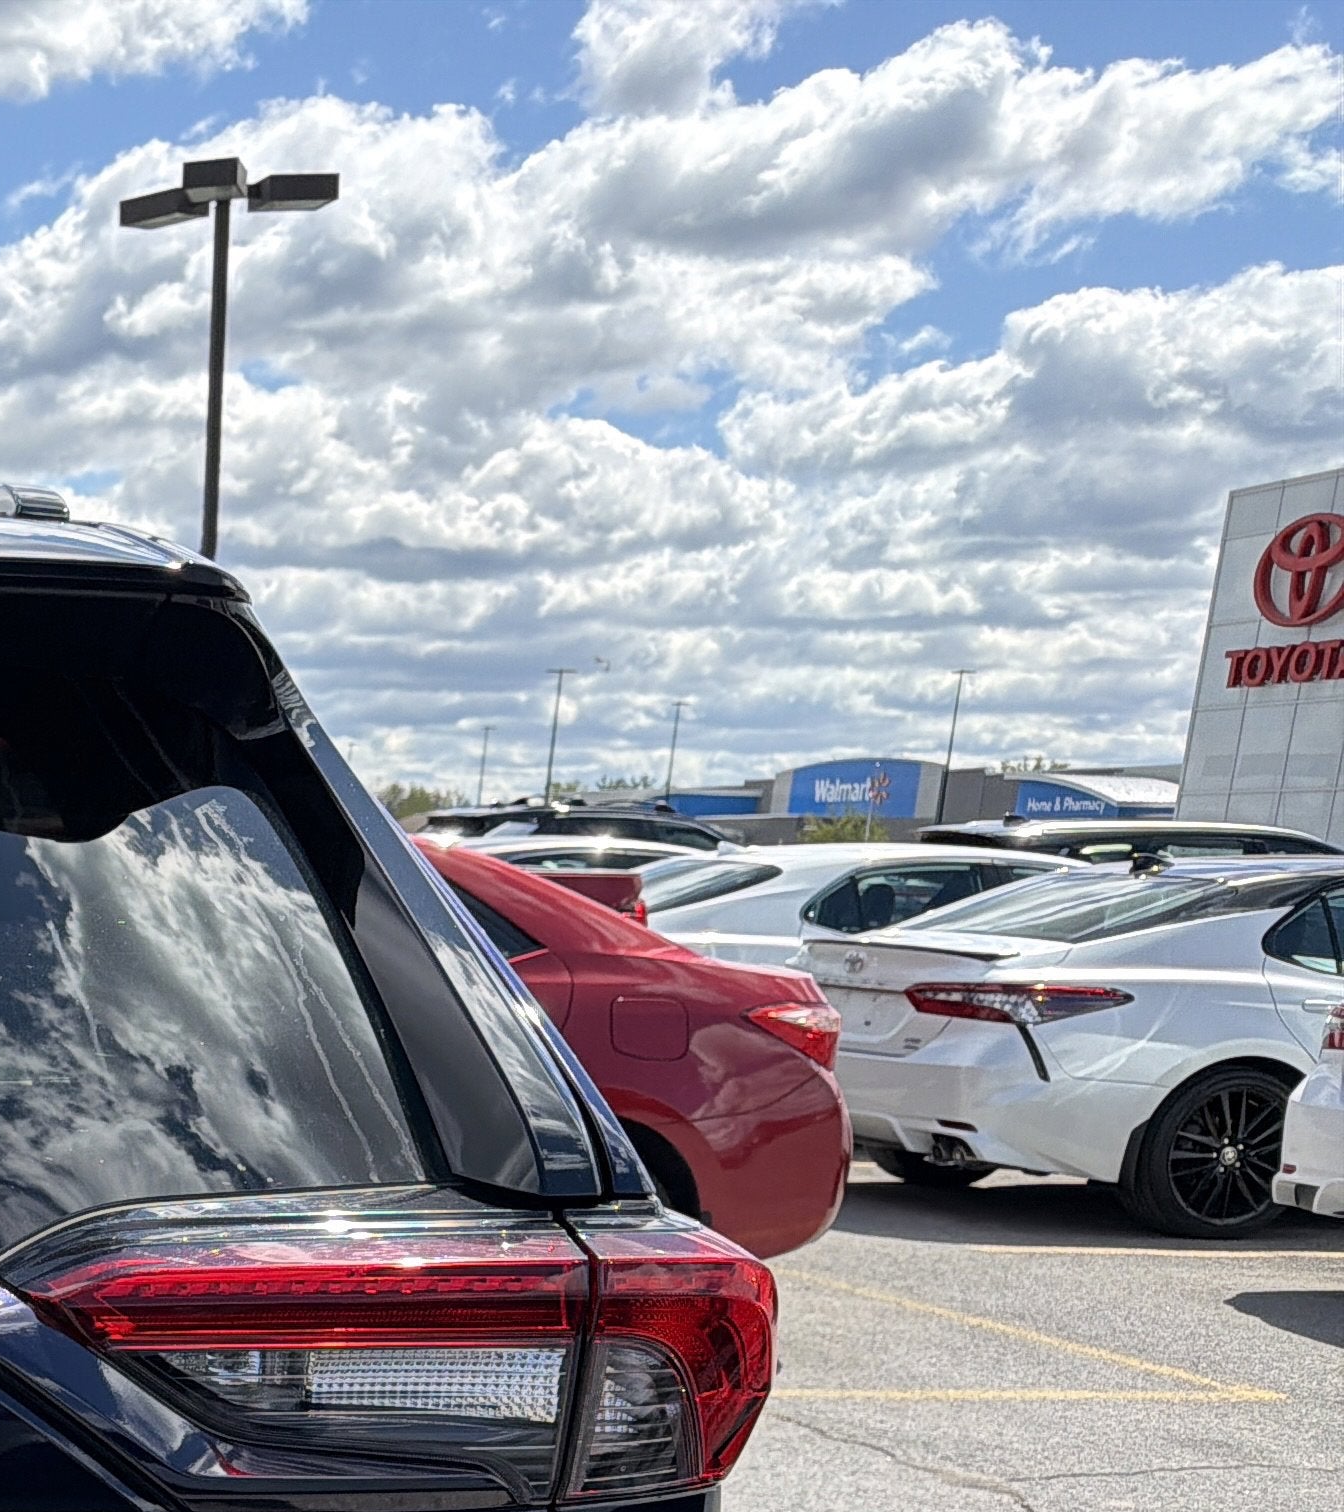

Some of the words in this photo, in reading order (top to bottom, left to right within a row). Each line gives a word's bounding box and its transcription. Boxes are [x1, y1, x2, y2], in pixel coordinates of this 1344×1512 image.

[814, 777, 872, 803] Walmart
[1027, 797, 1052, 812] Home
[1053, 796, 1061, 811] &
[1062, 796, 1106, 815] Pharmacy
